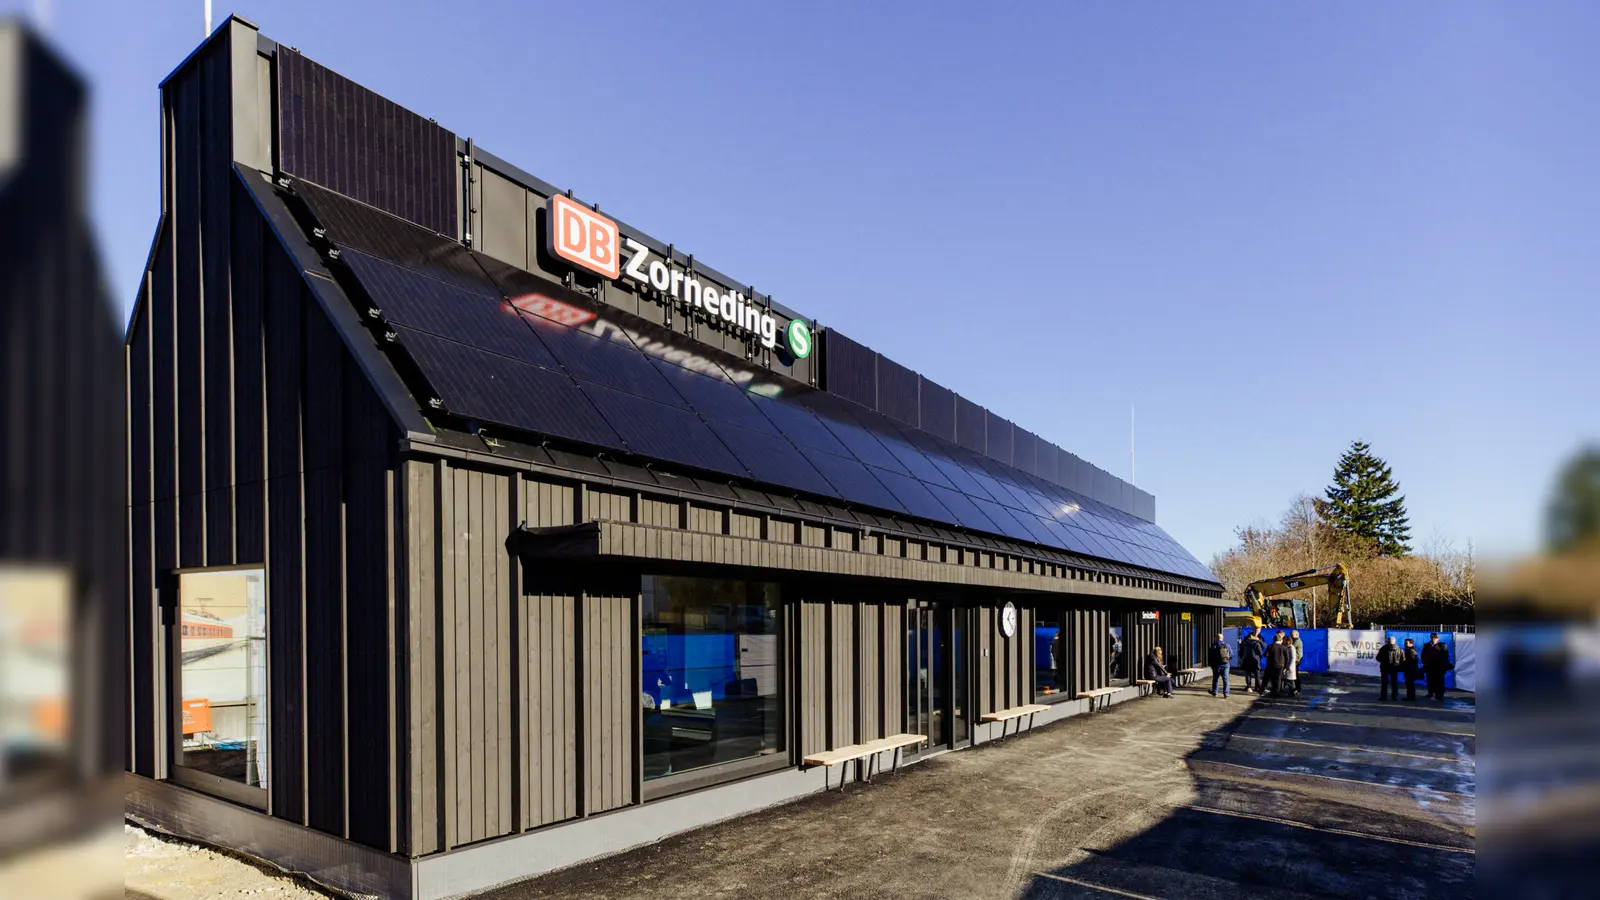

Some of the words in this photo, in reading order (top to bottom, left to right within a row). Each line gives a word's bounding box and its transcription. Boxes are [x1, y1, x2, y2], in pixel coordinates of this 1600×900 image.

[563, 207, 612, 265] DB
[626, 237, 776, 349] Zorneding
[792, 321, 808, 355] S
[1351, 640, 1381, 651] WADLE
[1357, 650, 1374, 660] BAU
